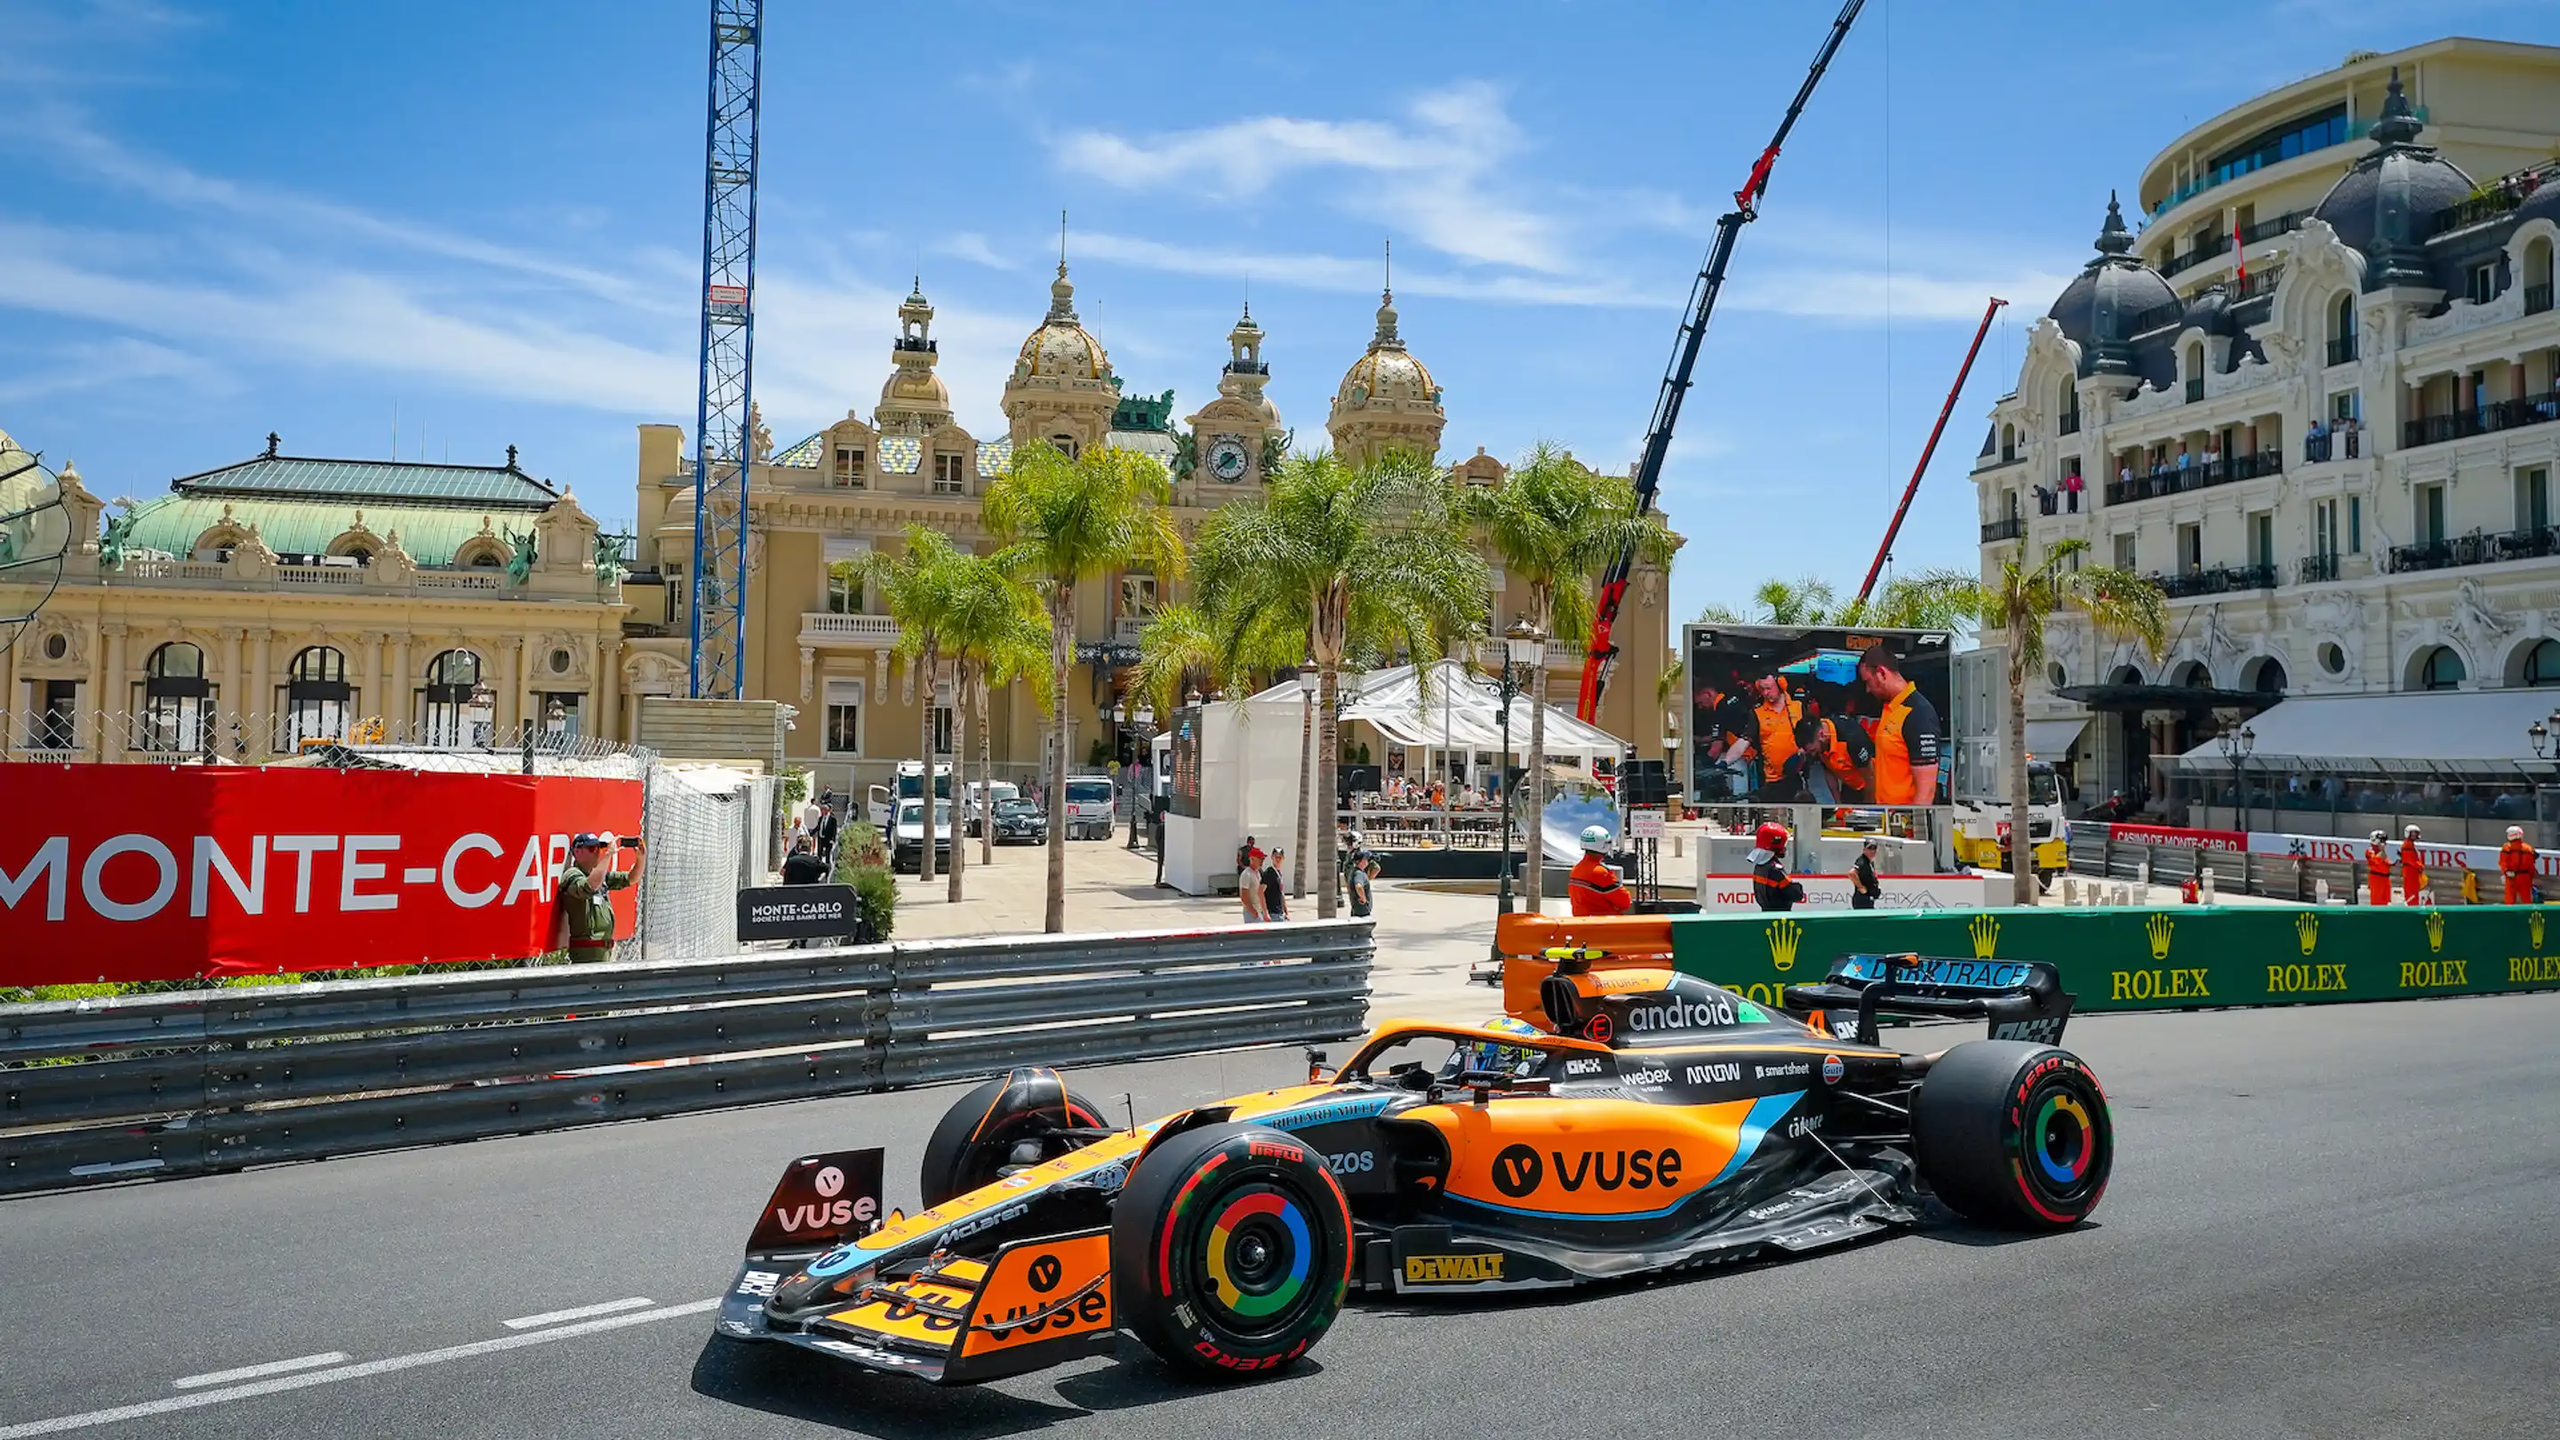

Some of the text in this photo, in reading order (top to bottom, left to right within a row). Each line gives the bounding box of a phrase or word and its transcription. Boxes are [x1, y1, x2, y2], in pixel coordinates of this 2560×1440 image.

[2111, 968, 2210, 1000] ROLEX
[2267, 964, 2347, 993] ROLEX
[2399, 960, 2468, 987] ROLEX
[1628, 995, 1735, 1031] android
[1620, 1066, 1673, 1086] webex
[1765, 1062, 1810, 1077] smartsheet
[1272, 1102, 1376, 1129] RICHARD MILLE
[1250, 1139, 1304, 1163] PIRELLI
[1552, 1147, 1682, 1192] vuse
[777, 1196, 877, 1232] vuse
[934, 1202, 1029, 1249] McLaren
[983, 1290, 1106, 1341] vuse
